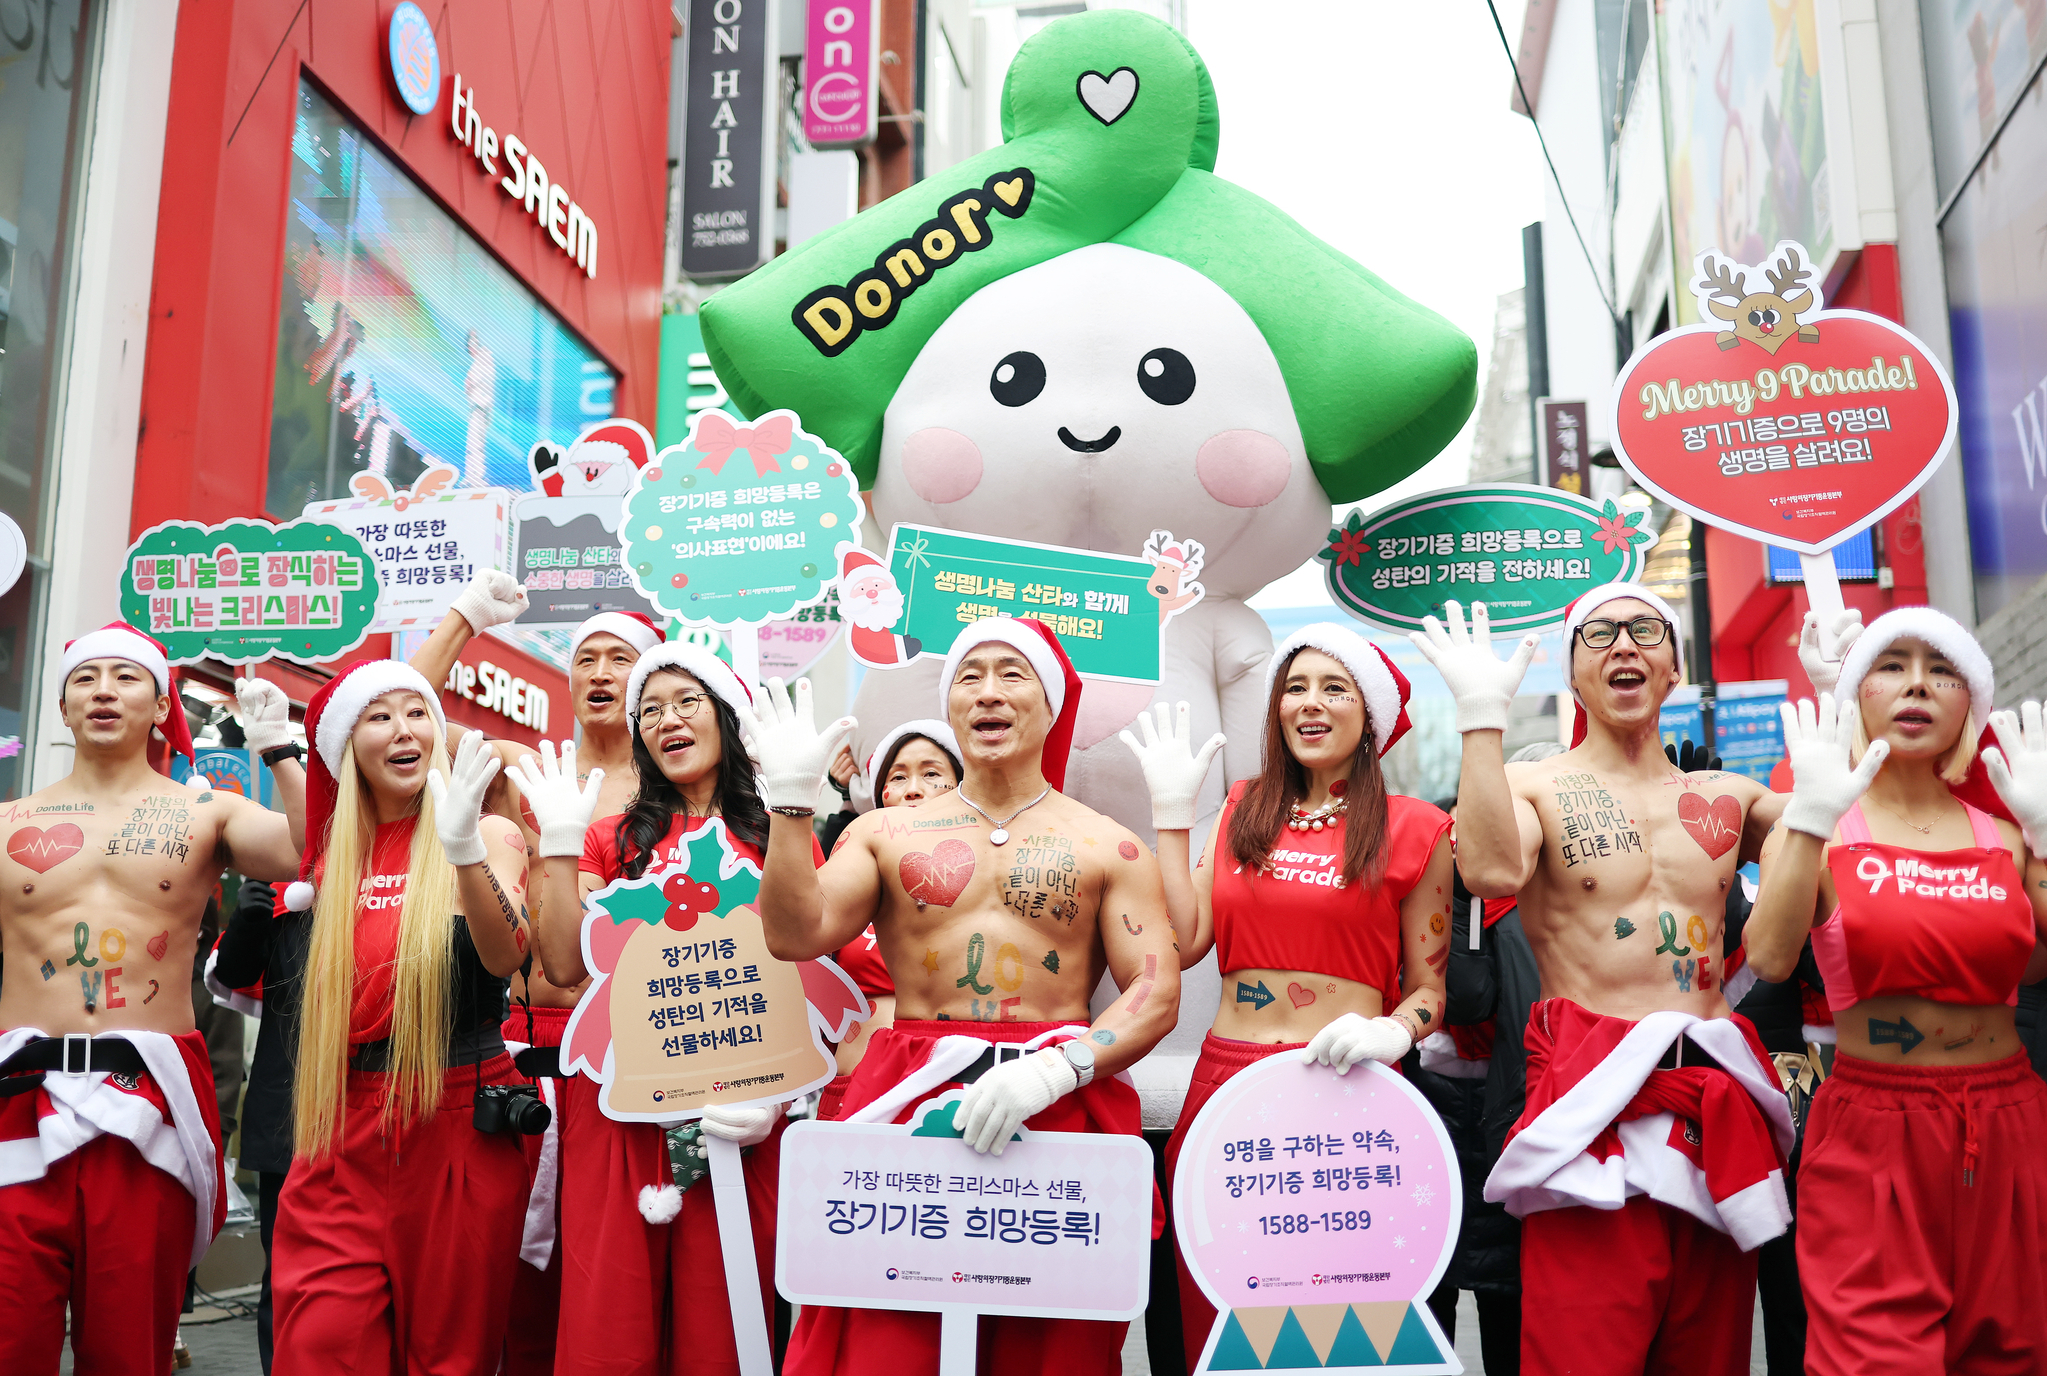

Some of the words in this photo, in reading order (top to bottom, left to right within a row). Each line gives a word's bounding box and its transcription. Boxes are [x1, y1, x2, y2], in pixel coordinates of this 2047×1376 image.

[710, 69, 741, 189] HAIR
[452, 72, 499, 176] the
[501, 133, 598, 280] SAEM
[692, 210, 747, 230] SALON
[801, 196, 983, 348] Donor
[1639, 377, 1755, 421] Merry
[1756, 366, 1780, 401] 9
[1781, 355, 1918, 399] Parade!
[1682, 412, 1826, 452] 장기기증으로
[1827, 406, 1891, 433] 9명의
[1718, 445, 1790, 477] 생명을
[1793, 438, 1873, 467] 살려요!
[658, 490, 728, 514] 장기기증
[733, 481, 821, 505] 희망등록은
[356, 524, 389, 542] 가장
[394, 519, 447, 539] 따뜻한
[686, 512, 754, 535] 구속력이
[760, 508, 796, 528] 없는
[425, 541, 465, 561] 선물,
[525, 548, 579, 568] 생명나눔
[671, 531, 806, 559] '의사표현'이에요!
[1377, 533, 1455, 561] 장기기증
[1461, 528, 1584, 553] 희망등록으로
[134, 552, 261, 591] 생명나눔으로
[267, 554, 358, 588] 장식하는
[396, 564, 473, 586] 희망등록!
[524, 571, 564, 589] 소중한
[1371, 563, 1430, 590] 성탄의
[1437, 560, 1496, 584] 기적을
[1501, 557, 1591, 581] 전하세요!
[933, 570, 1016, 601] 생명나눔
[1021, 583, 1079, 608] 산타와
[1084, 590, 1130, 615] 함께
[153, 597, 213, 629] 빛나는
[219, 595, 339, 626] 크리스마스!
[476, 660, 549, 734] SAEM
[1554, 773, 1600, 790] 사랑의
[35, 804, 73, 813] Donate
[74, 802, 95, 812] Life
[131, 808, 190, 823] 장기기증
[146, 795, 187, 808] 사랑의
[1556, 789, 1614, 814] 장기기증
[121, 823, 152, 838] 끝이
[158, 823, 189, 842] 아닌
[913, 818, 953, 828] Donate
[955, 814, 977, 825] Life
[1563, 812, 1595, 840] 끝이
[1595, 809, 1629, 831] 아닌
[105, 839, 121, 856] 또
[125, 838, 156, 855] 다른
[160, 840, 190, 863] 시작
[1025, 834, 1072, 852] 사랑의
[1562, 843, 1579, 868] 또
[1580, 834, 1611, 858] 다른
[1615, 831, 1643, 854] 시작
[1016, 848, 1075, 873] 장기기증
[1895, 859, 1979, 881] Merry
[1897, 877, 2007, 901] Parade
[662, 938, 737, 968] 장기기증
[646, 964, 762, 999] 희망등록으로
[647, 1001, 705, 1030] 성탄의
[712, 992, 768, 1020] 기적을
[661, 1024, 763, 1058] 선물하세요!
[1223, 1138, 1275, 1163] 9명을
[1282, 1133, 1345, 1159] 구하는
[1352, 1128, 1400, 1154] 약속,
[842, 1169, 881, 1191] 가장
[885, 1171, 942, 1194] 따뜻한
[947, 1175, 1040, 1198] 크리스마스
[1046, 1179, 1087, 1204] 선물,
[1225, 1171, 1305, 1199] 장기기증
[1312, 1164, 1402, 1191] 희망등록!
[825, 1199, 950, 1240] 장기기증
[963, 1205, 1101, 1247] 희망등록!
[1258, 1209, 1372, 1236] 1588-1589
